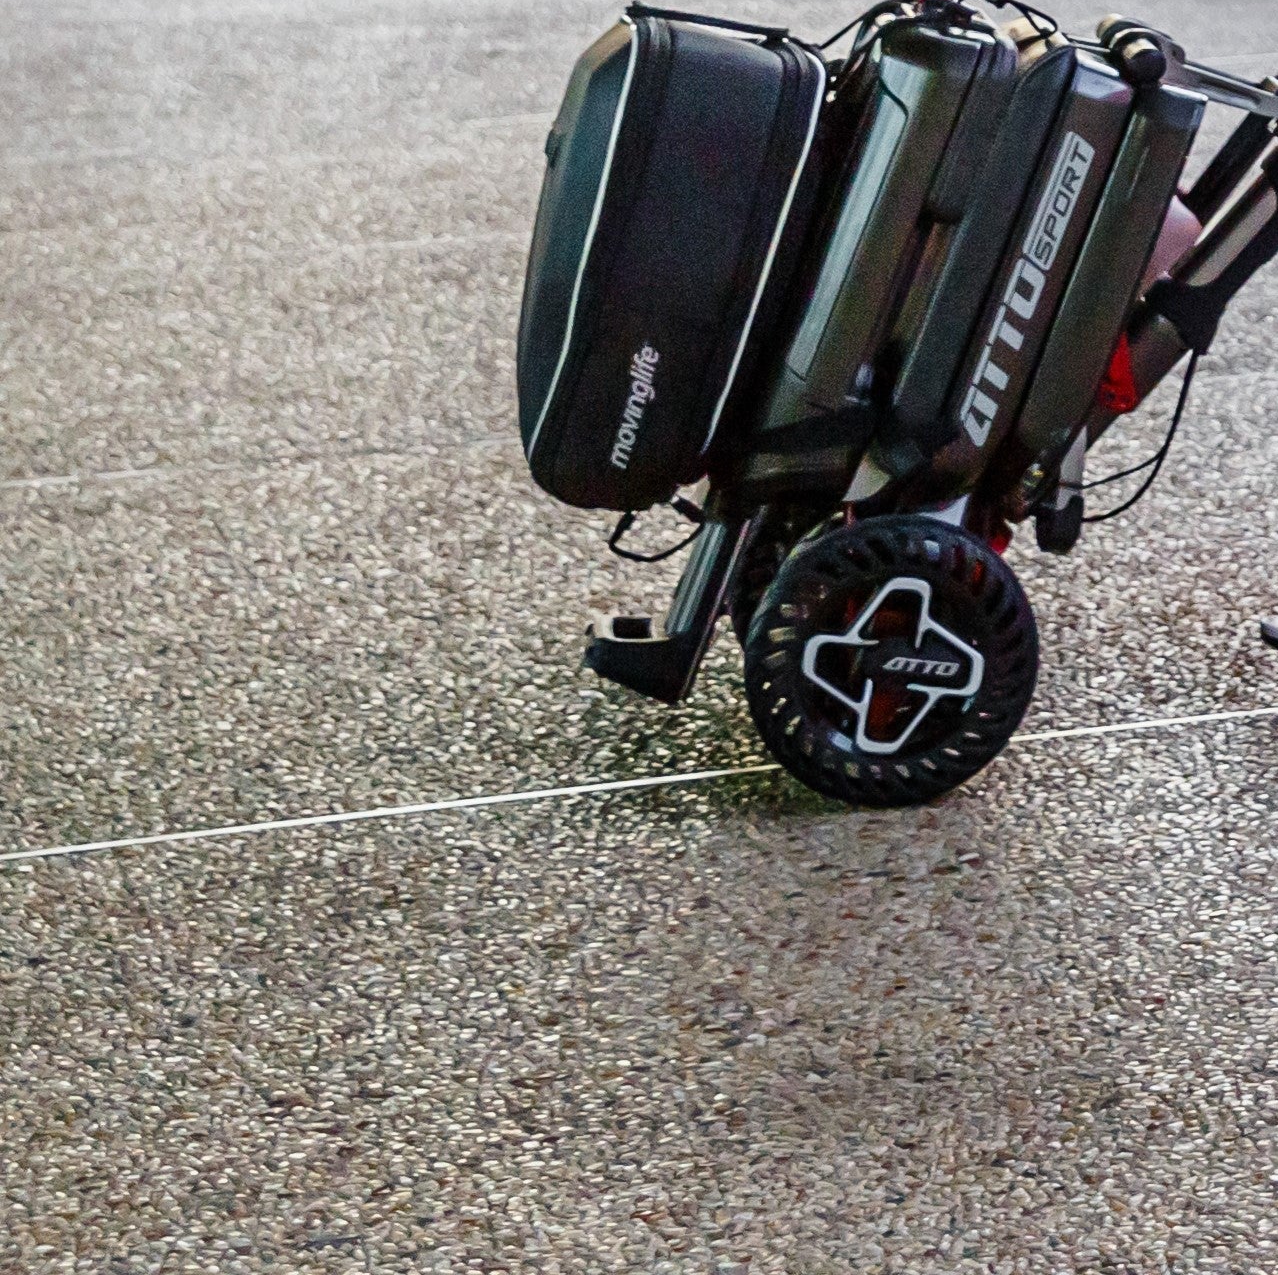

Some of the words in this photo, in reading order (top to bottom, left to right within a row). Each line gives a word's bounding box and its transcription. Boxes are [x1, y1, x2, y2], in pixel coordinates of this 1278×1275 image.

[960, 257, 1046, 447] ATTO
[1032, 142, 1087, 264] SPORT
[611, 345, 660, 469] movinglife
[882, 656, 960, 676] ATTO
